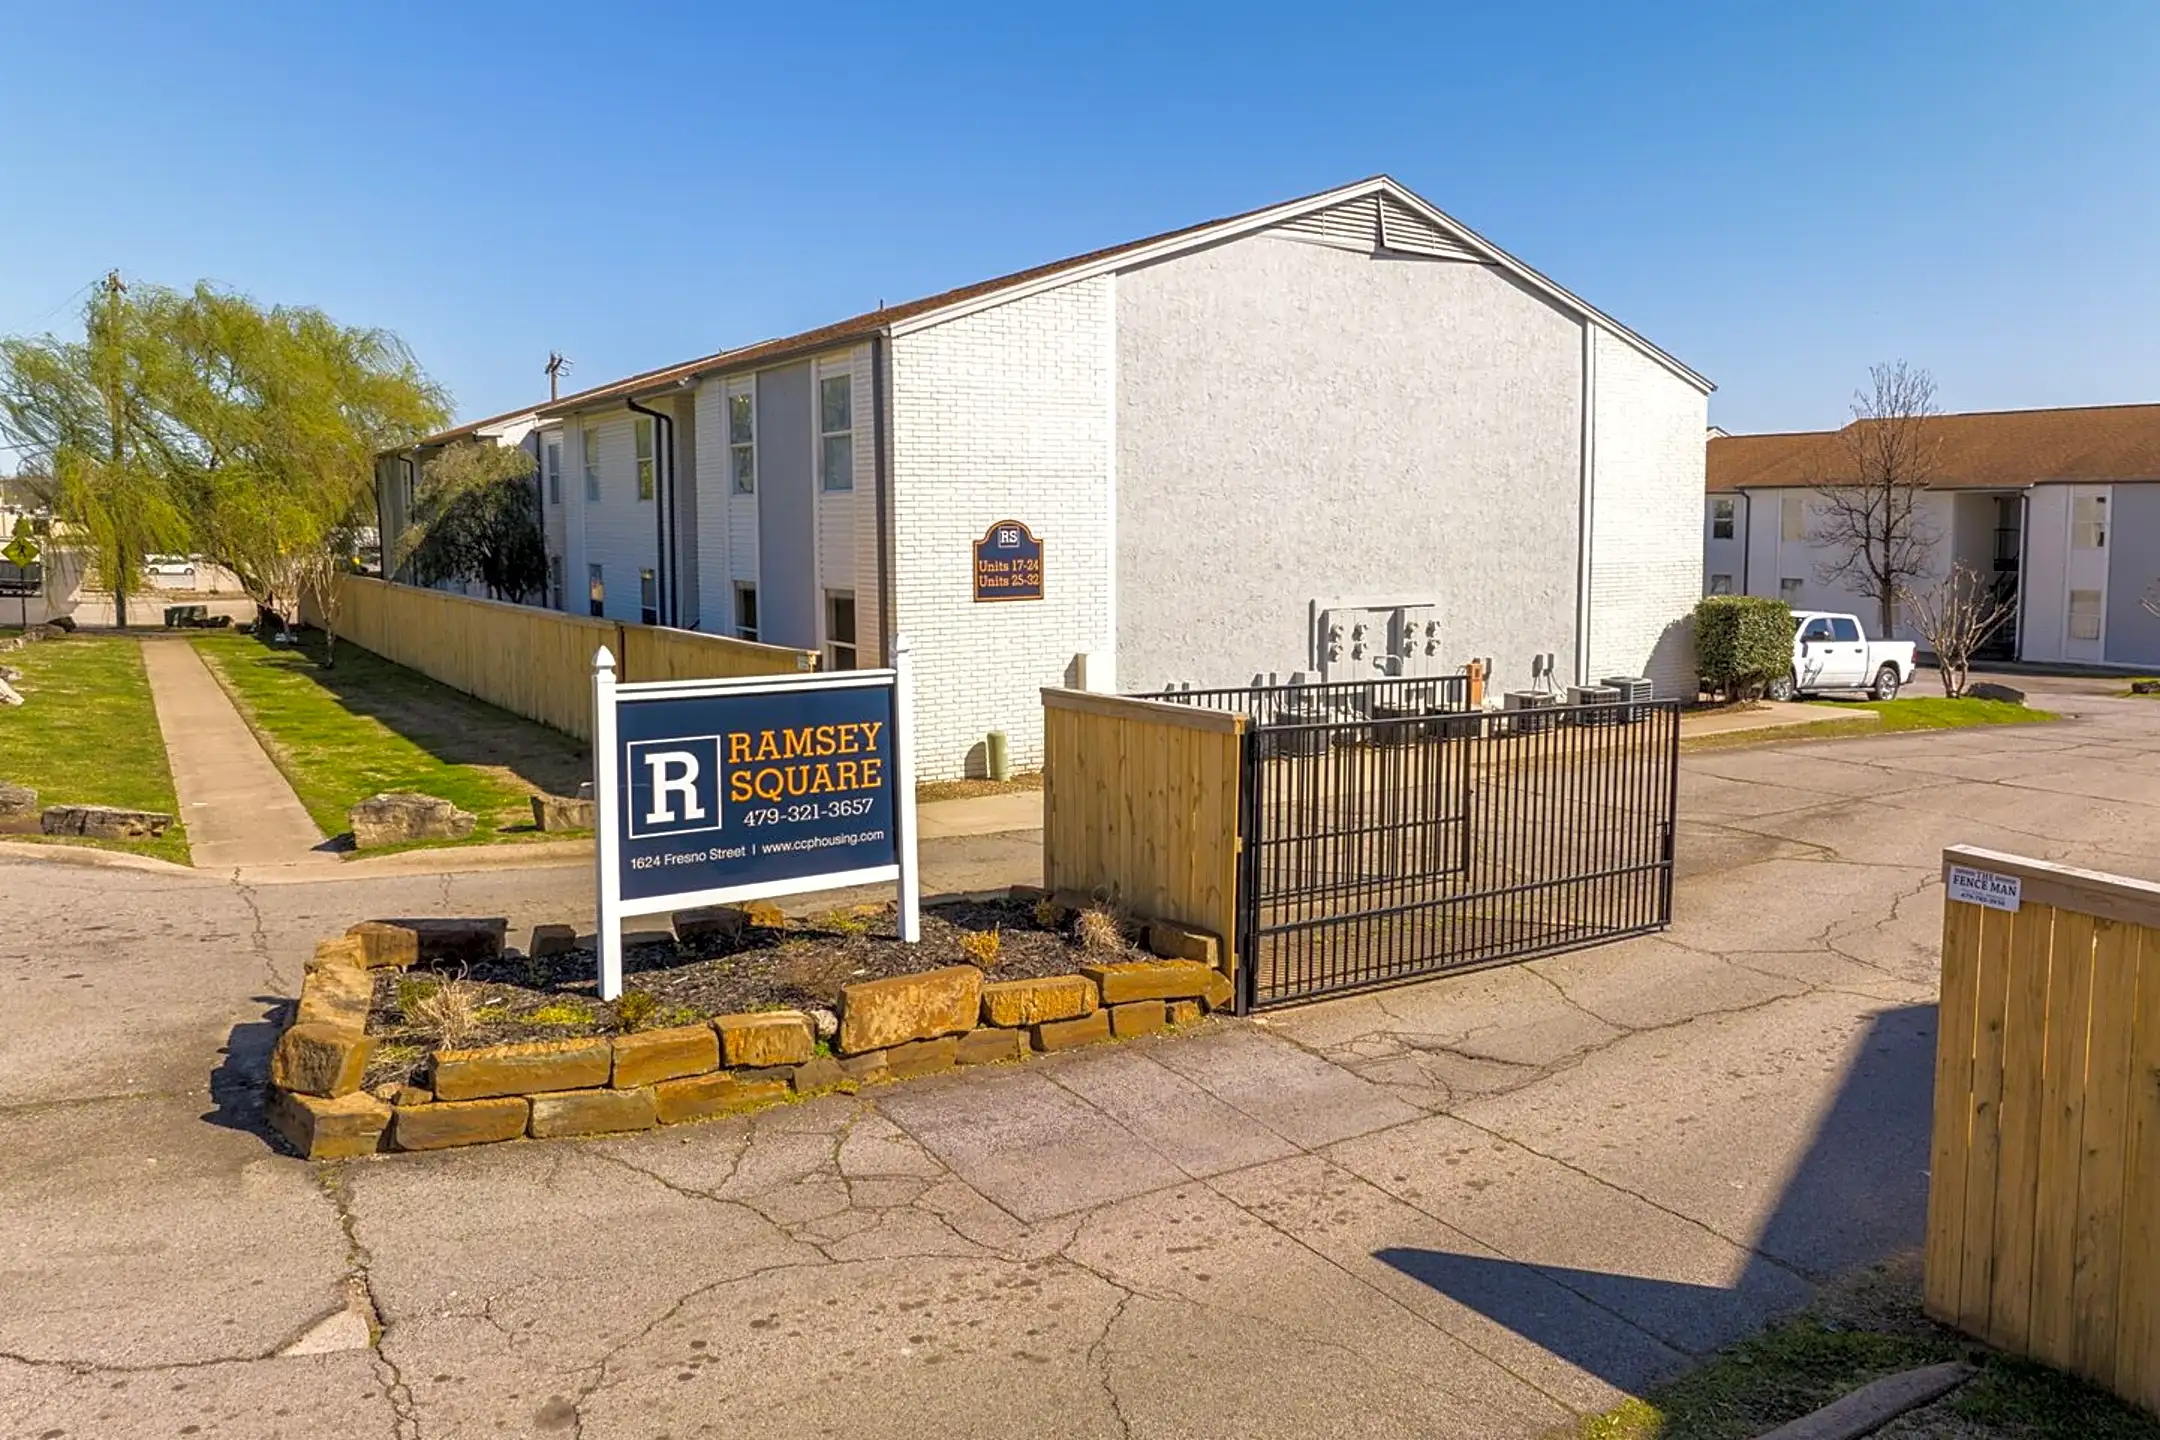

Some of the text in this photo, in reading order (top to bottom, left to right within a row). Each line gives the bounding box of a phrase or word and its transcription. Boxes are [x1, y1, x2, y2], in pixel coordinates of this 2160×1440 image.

[1001, 530, 1018, 543] RS
[979, 559, 1039, 572] Units 17-24
[979, 573, 1039, 587] Units 25-32
[728, 721, 883, 764] RAMSEY
[645, 750, 705, 825] R
[730, 758, 882, 802] SQUARE
[743, 798, 873, 827] 479-321-3657
[631, 855, 661, 870] 1624
[664, 851, 707, 866] Fresno
[709, 845, 746, 861] Street
[762, 830, 884, 854] www.ccphousing.com
[1953, 875, 1988, 891] FENCE
[1991, 882, 2017, 897] MAN
[1976, 871, 1994, 881] THE
